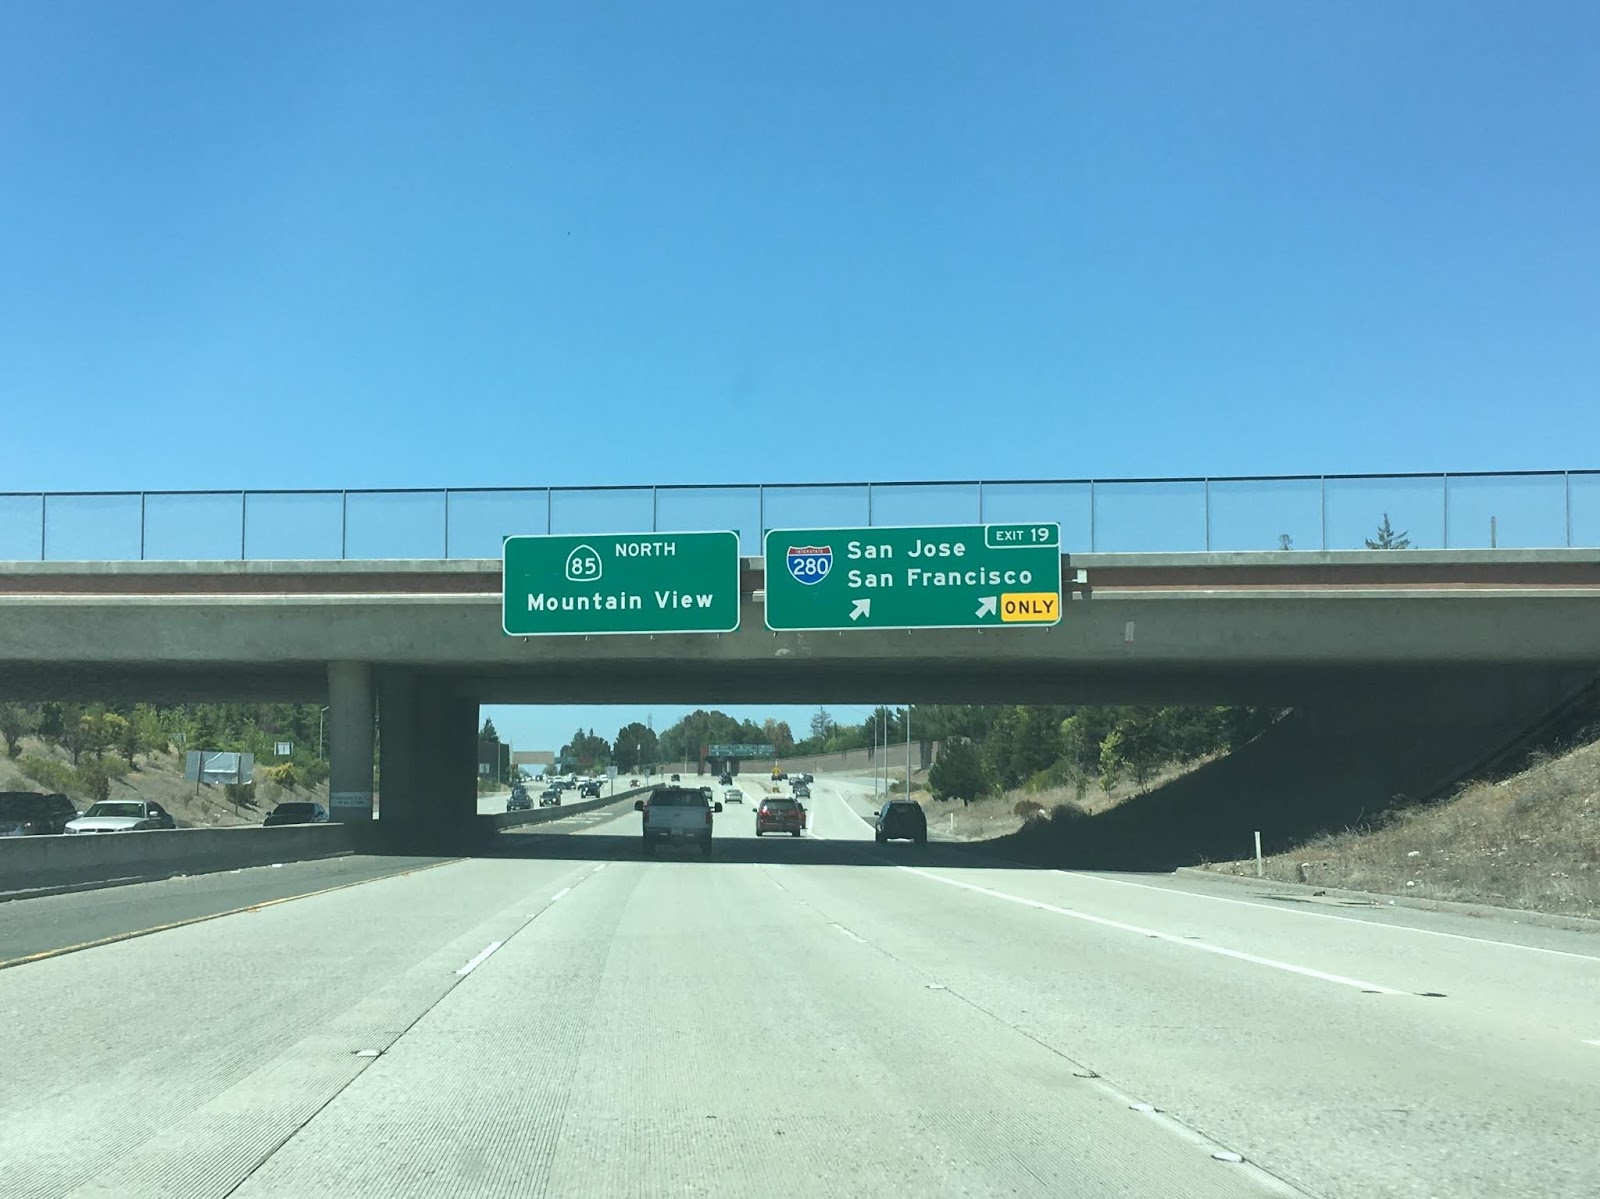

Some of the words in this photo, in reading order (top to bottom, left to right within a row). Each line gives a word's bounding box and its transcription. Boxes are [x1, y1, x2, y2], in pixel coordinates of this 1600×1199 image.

[996, 530, 1024, 541] EXIT
[1031, 528, 1049, 542] 19
[615, 542, 676, 557] NORTH
[847, 541, 893, 559] San
[907, 539, 966, 558] Jose
[571, 558, 596, 575] 85
[794, 558, 828, 575] 280
[848, 570, 893, 588] San
[907, 567, 1033, 587] Francisco
[527, 592, 642, 611] Mountain
[654, 590, 714, 609] View
[1005, 600, 1054, 615] ONLY
